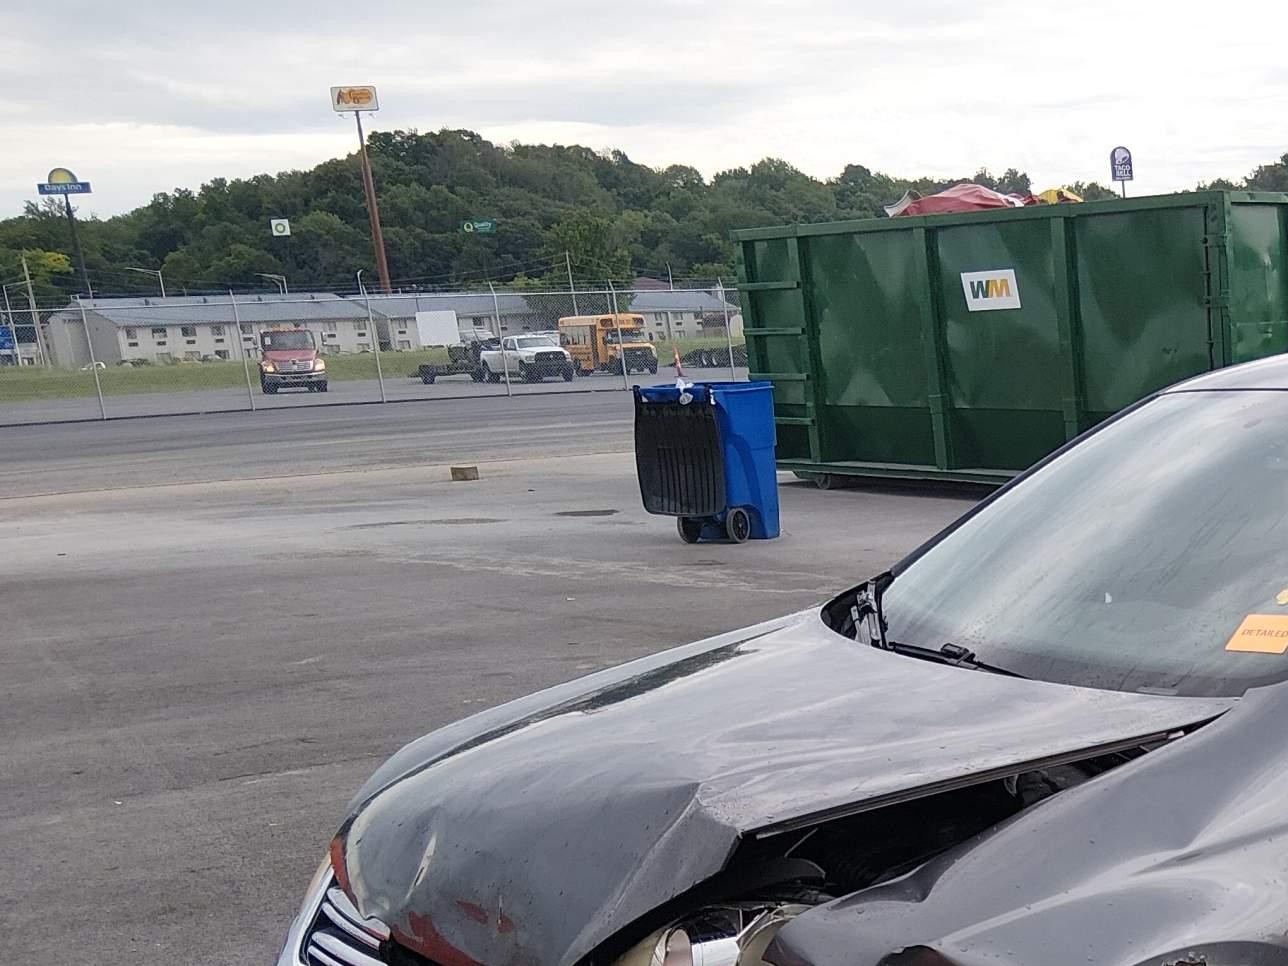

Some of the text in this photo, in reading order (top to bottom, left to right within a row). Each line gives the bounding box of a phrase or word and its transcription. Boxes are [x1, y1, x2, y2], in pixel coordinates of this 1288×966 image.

[44, 183, 83, 192] Days Inn
[969, 278, 1011, 299] WM
